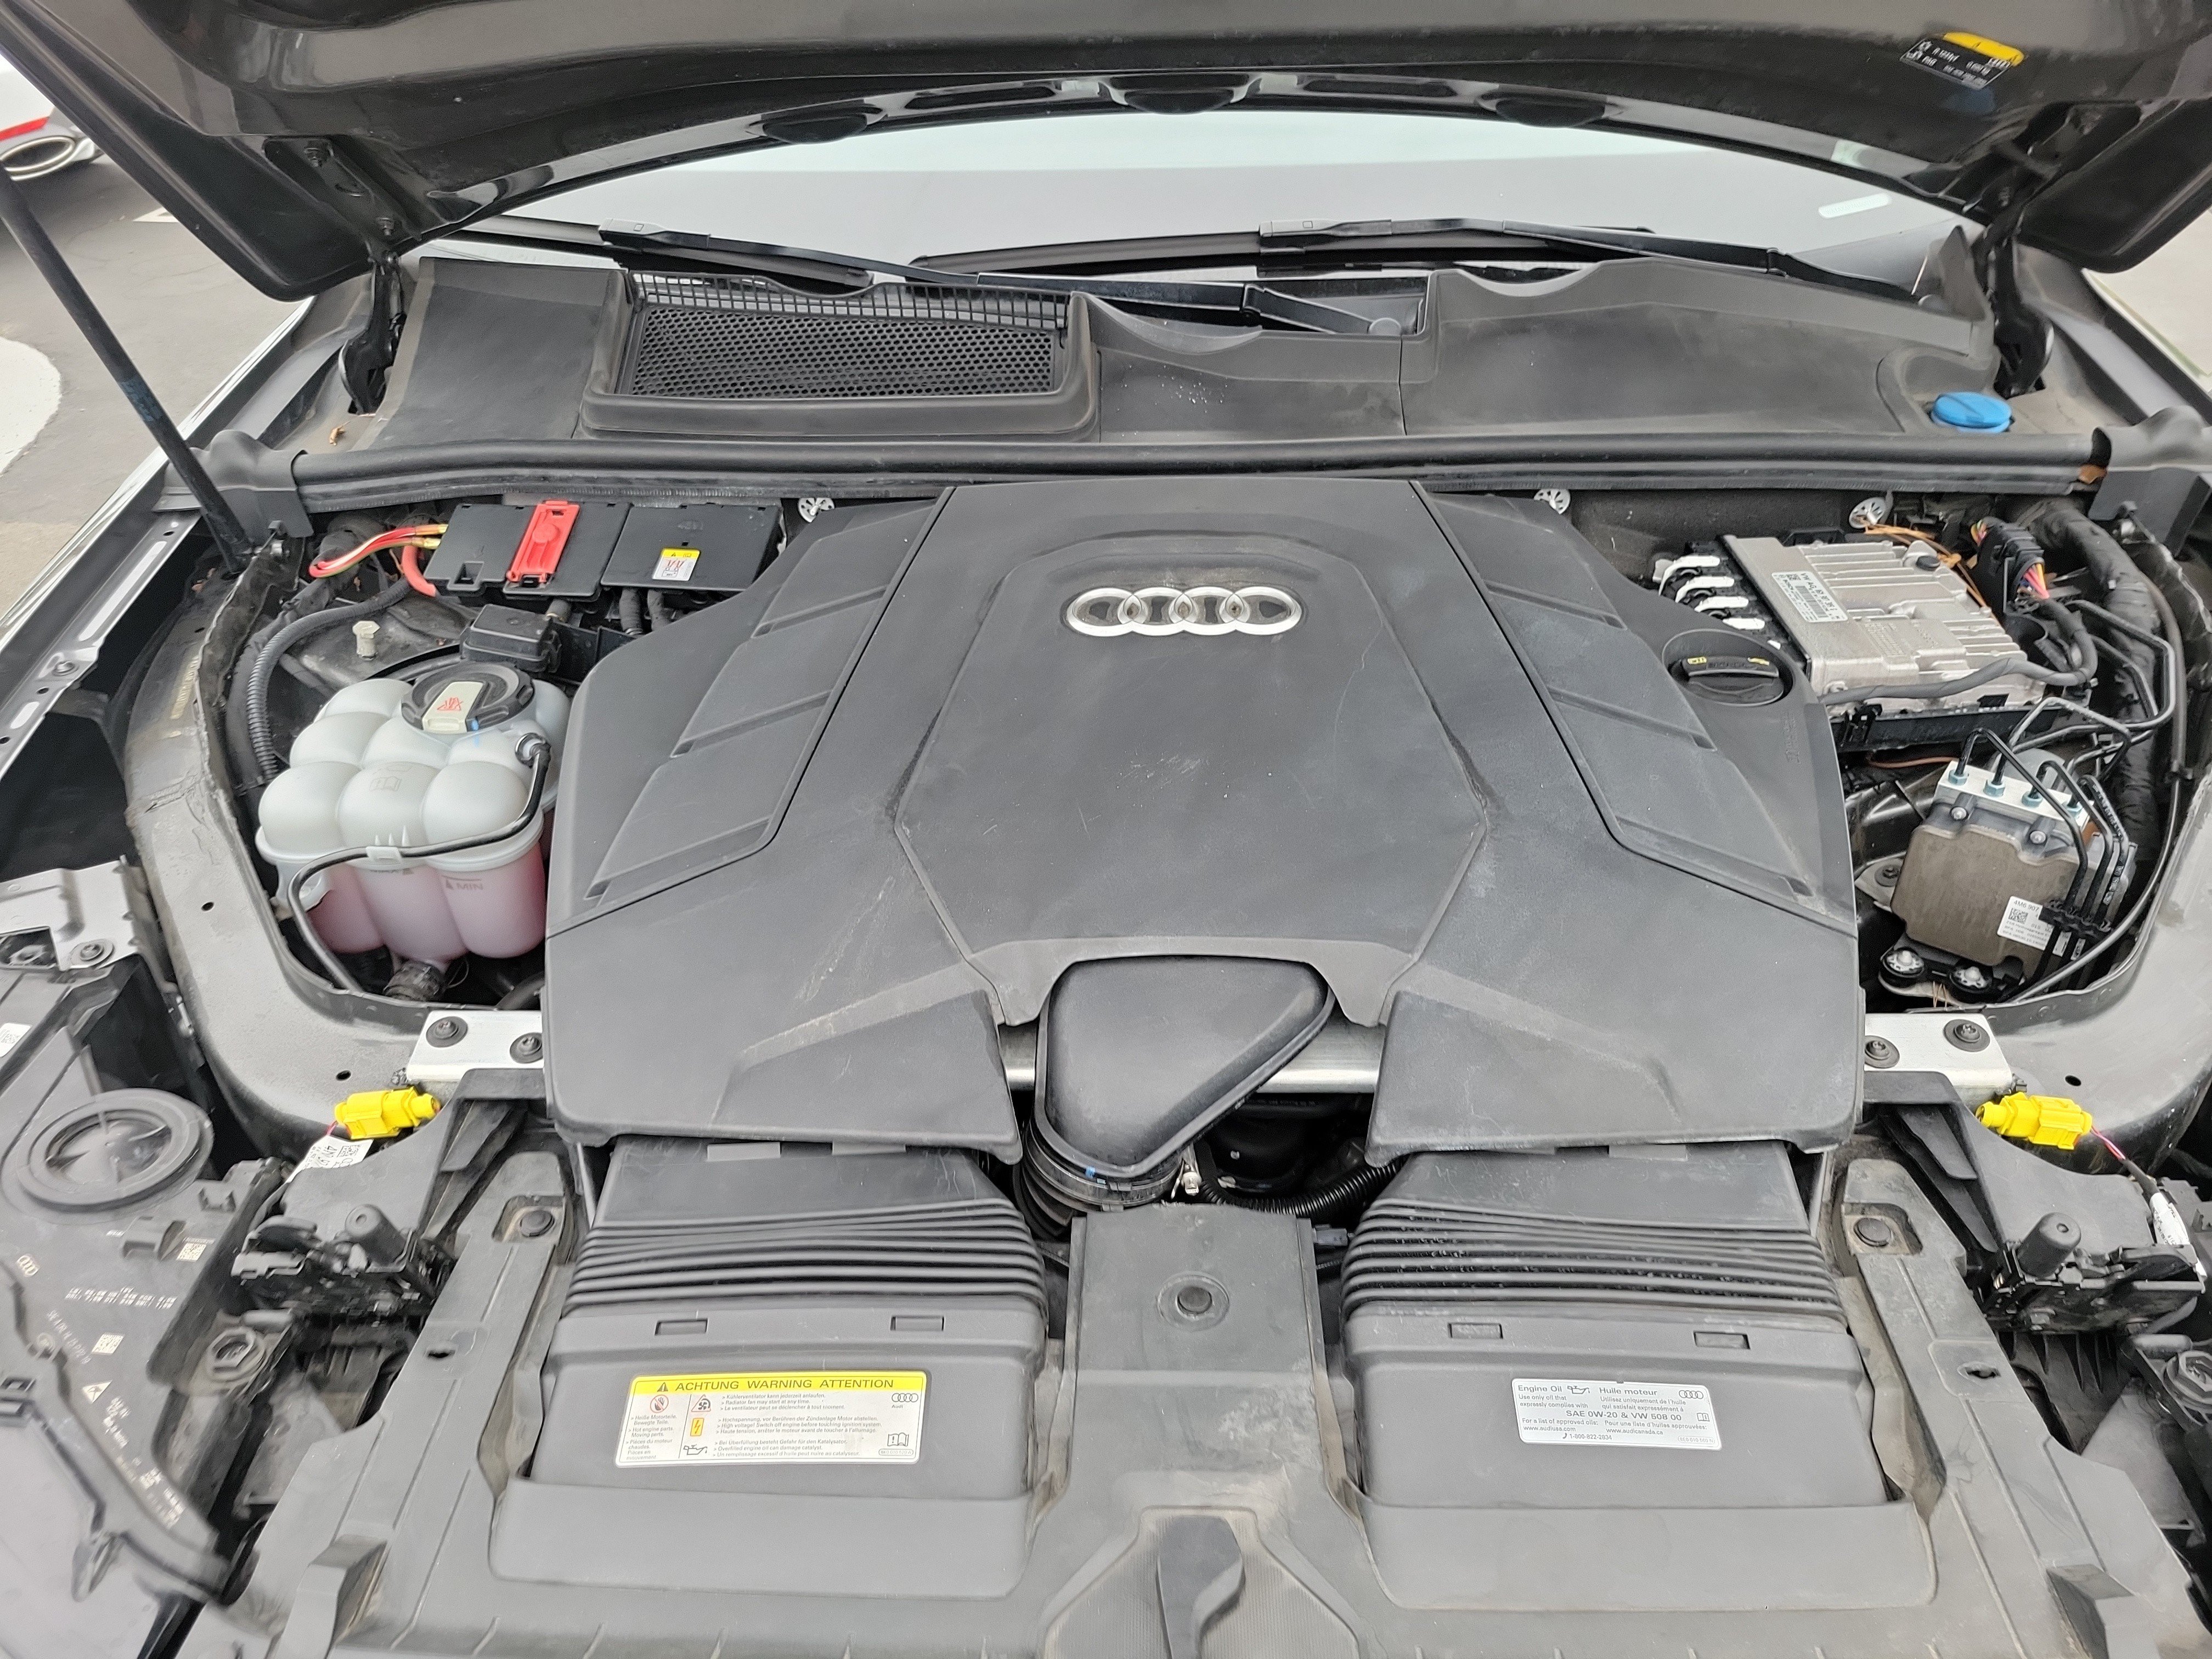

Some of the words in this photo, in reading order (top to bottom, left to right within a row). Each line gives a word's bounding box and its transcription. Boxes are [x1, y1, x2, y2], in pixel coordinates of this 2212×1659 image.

[675, 1381, 739, 1391] ACHTUNG
[747, 1380, 812, 1389] WARNING
[819, 1379, 893, 1388] ATTENTION
